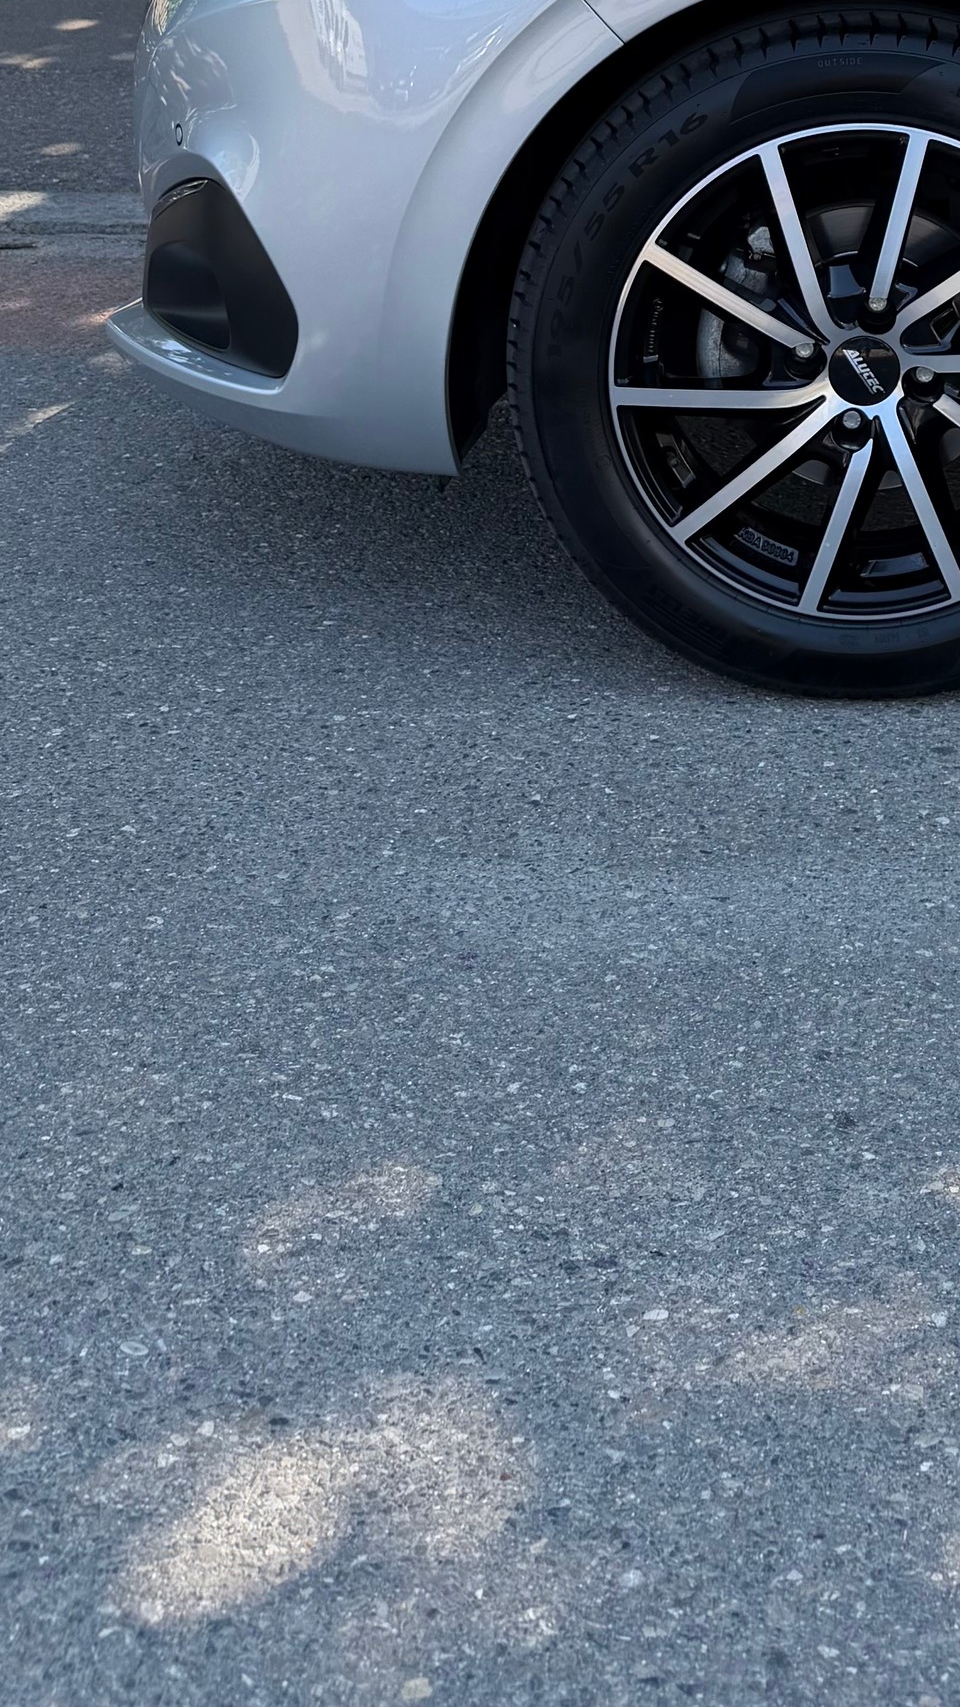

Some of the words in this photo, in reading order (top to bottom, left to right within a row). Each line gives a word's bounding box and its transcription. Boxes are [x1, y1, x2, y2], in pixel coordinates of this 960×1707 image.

[817, 57, 863, 69] OUTSIDE
[629, 112, 708, 178] R16
[842, 349, 884, 394] ALUTEC
